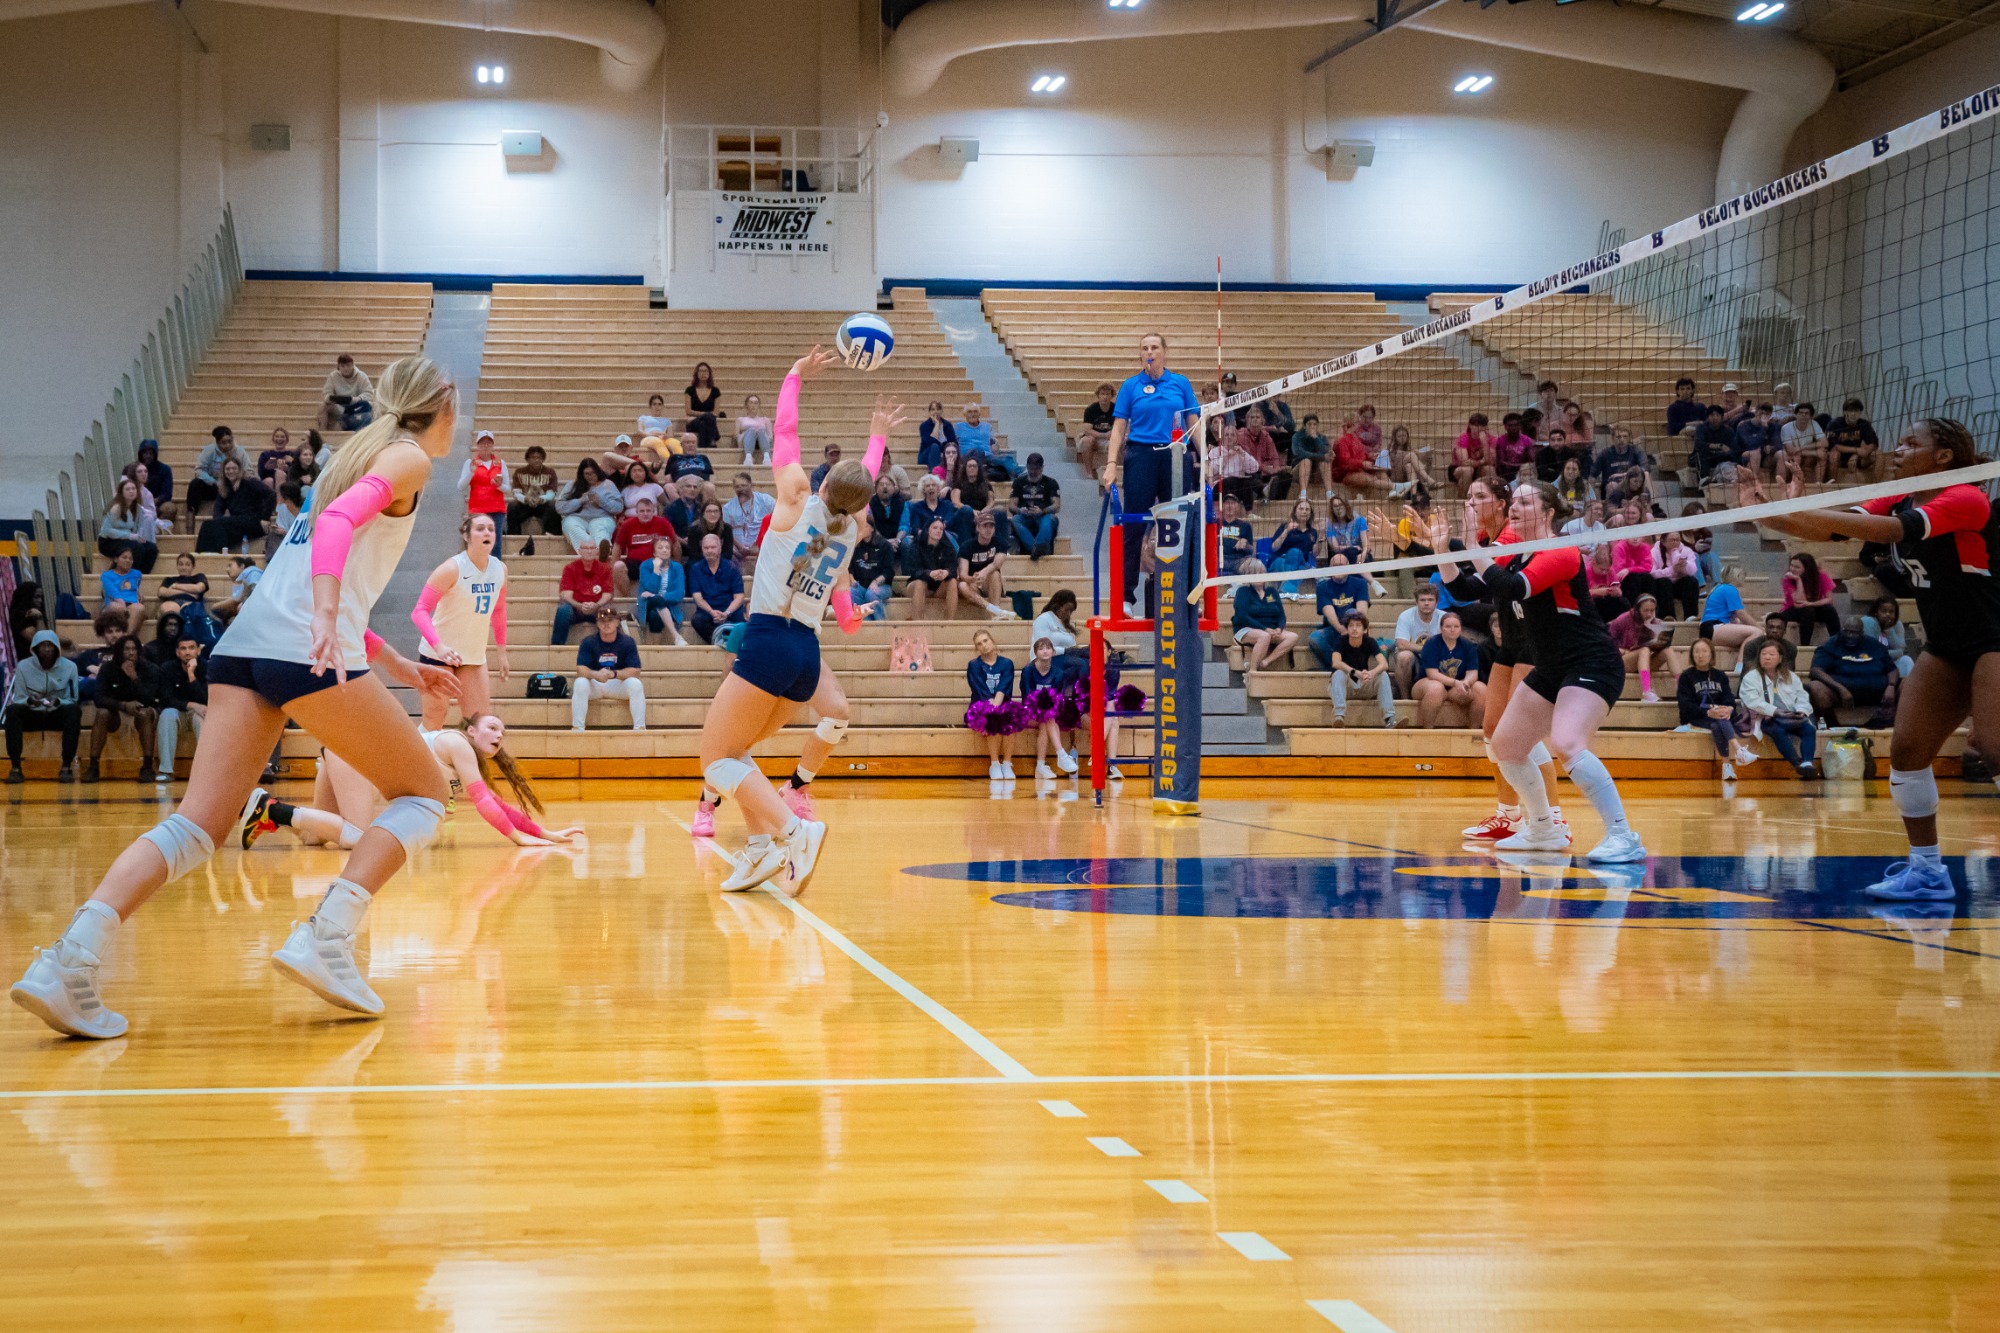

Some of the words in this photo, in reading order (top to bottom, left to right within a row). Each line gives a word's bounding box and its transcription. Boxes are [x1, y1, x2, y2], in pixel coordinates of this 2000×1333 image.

[1941, 86, 2000, 130] BELOIT
[1872, 134, 1890, 158] B
[1699, 198, 1740, 230] BELOIT
[1743, 160, 1828, 212] BUCCANEERS
[732, 209, 817, 233] MIDWEST
[718, 241, 774, 251] HAPPENS
[780, 243, 792, 251] IN
[798, 243, 829, 252] HERE
[1651, 231, 1663, 249] B
[1528, 273, 1559, 299] BELOIT
[1560, 249, 1621, 286] BUCCANEERS
[1494, 296, 1504, 311] B
[1375, 343, 1384, 356] B
[1156, 518, 1181, 547] B
[471, 582, 496, 594] BELOIT
[474, 595, 491, 615] 13
[1160, 571, 1176, 670] BELOIT
[1159, 678, 1179, 793] COLLEGE
